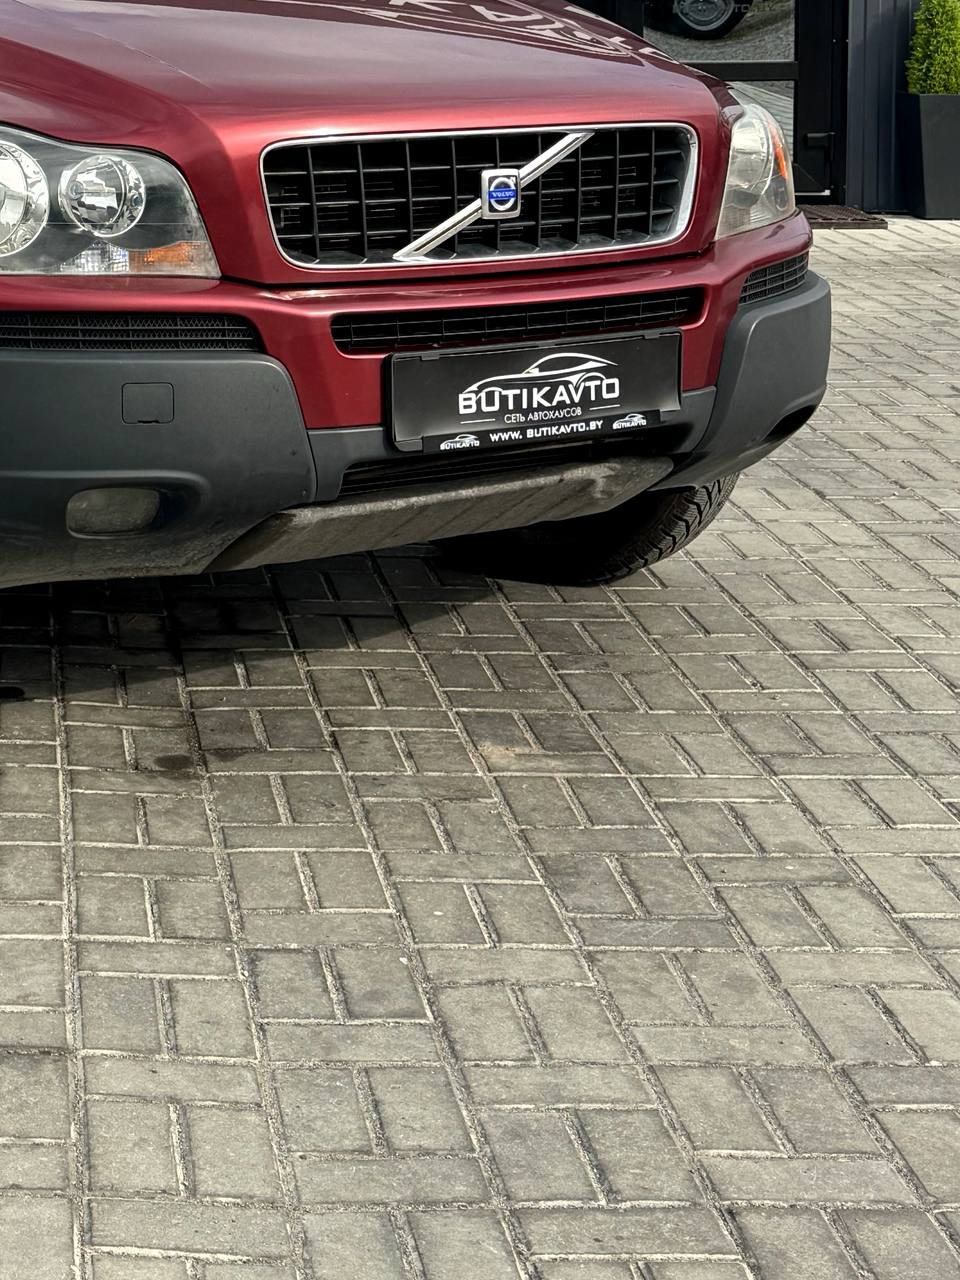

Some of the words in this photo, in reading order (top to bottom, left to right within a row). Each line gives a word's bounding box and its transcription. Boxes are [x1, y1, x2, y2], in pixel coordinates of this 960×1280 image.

[458, 376, 620, 414] BUTIKAVTO
[504, 412, 526, 424] СЕТЬ
[527, 406, 583, 422] АВТОХАУСОВ
[612, 417, 647, 430] BUTIKAVTO
[489, 430, 523, 443] WWW.
[526, 420, 604, 438] BUTIKAVTO.BY
[439, 438, 480, 451] BUTIKAVTO
